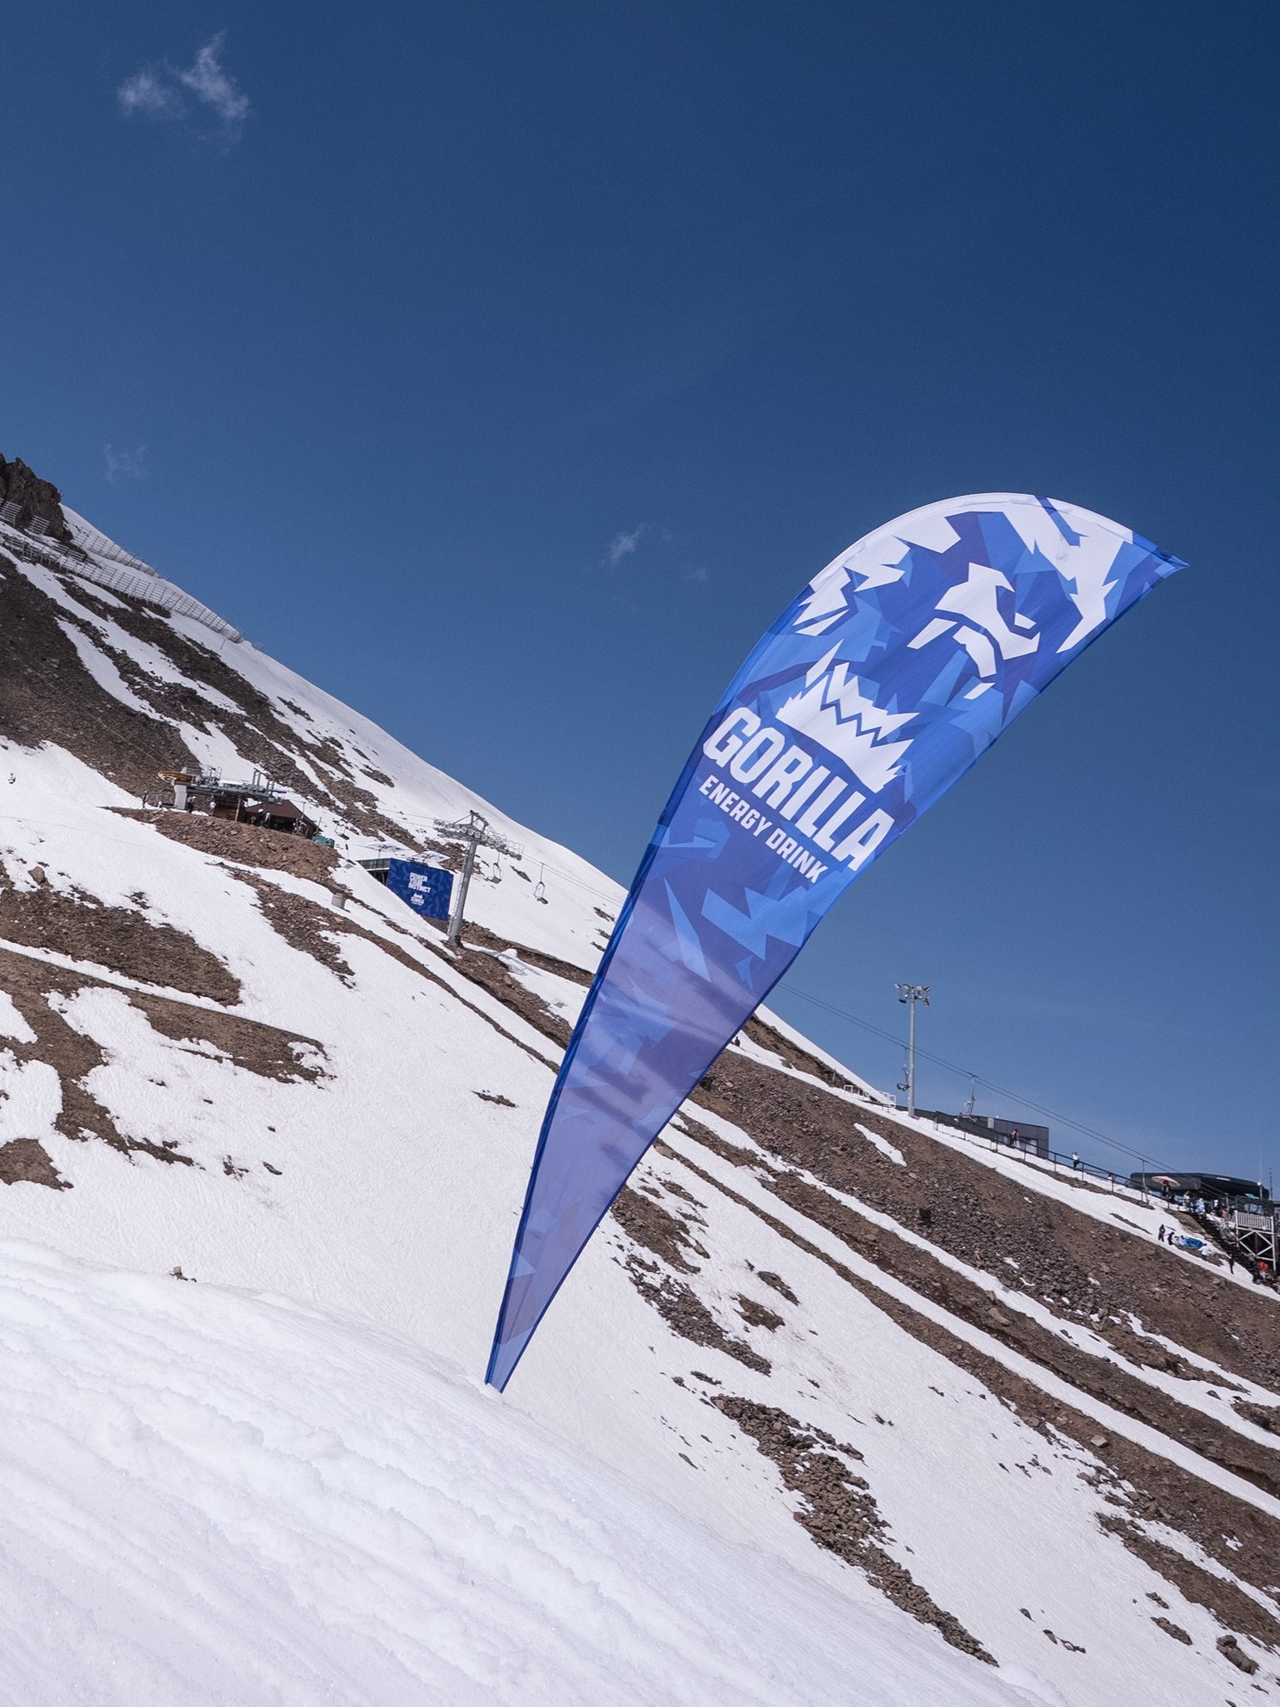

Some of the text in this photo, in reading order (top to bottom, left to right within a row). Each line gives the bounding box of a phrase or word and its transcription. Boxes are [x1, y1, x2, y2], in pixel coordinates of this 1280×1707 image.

[698, 774, 829, 884] ENERGY DRINK
[703, 706, 895, 871] GORILLA
